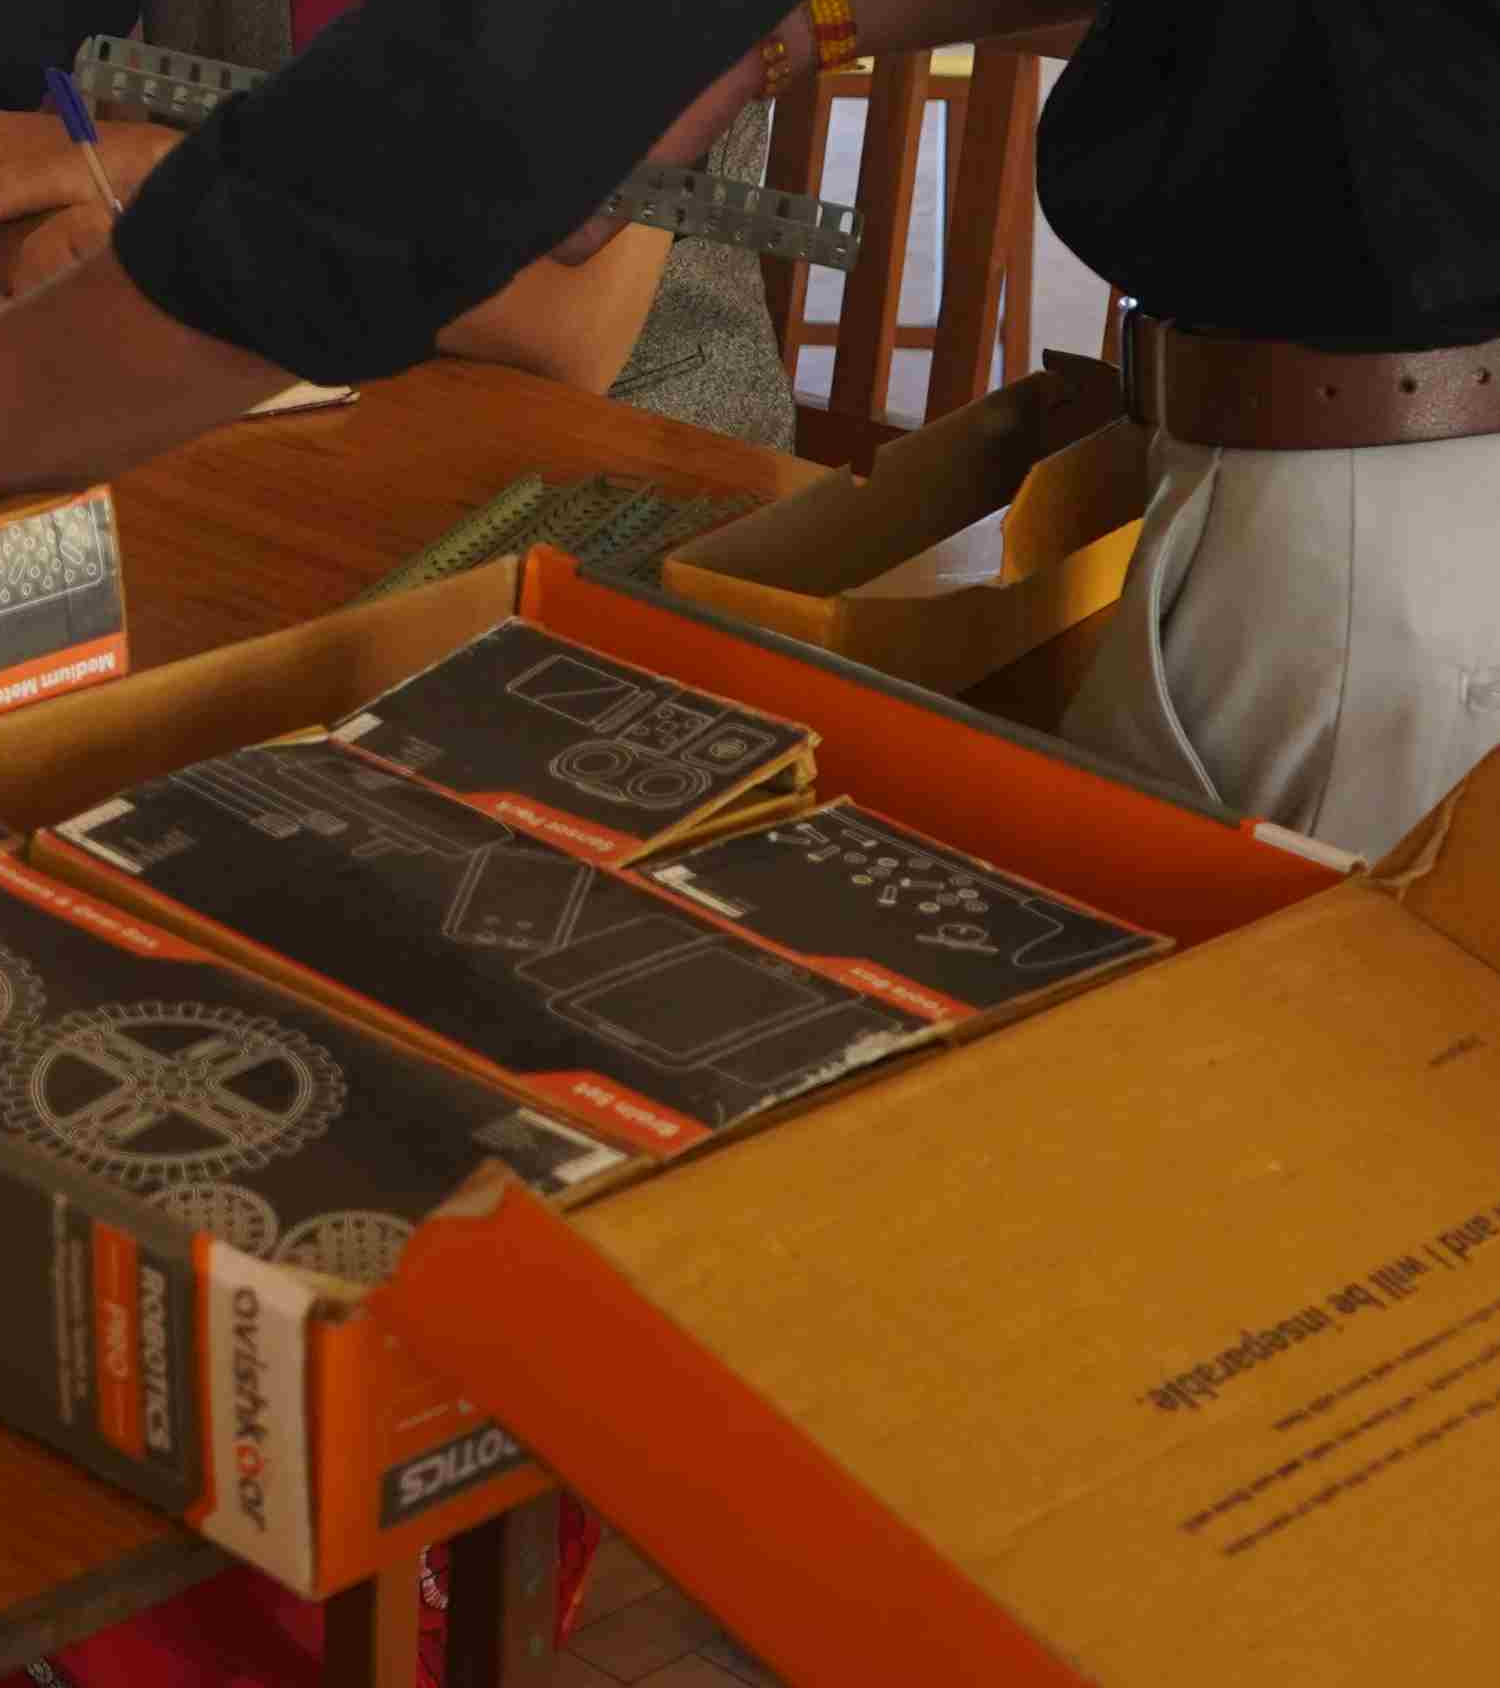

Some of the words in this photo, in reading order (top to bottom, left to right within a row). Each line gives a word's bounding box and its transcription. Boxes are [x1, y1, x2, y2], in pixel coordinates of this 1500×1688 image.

[39, 652, 115, 689] Medium
[1437, 1214, 1498, 1266] and
[1325, 1282, 1389, 1313] be
[1367, 1255, 1428, 1301] will
[103, 1302, 129, 1379] PRO
[141, 1265, 172, 1451] ROBOTICS
[1134, 1305, 1346, 1414] inseparable.
[399, 1427, 521, 1505] OTICS
